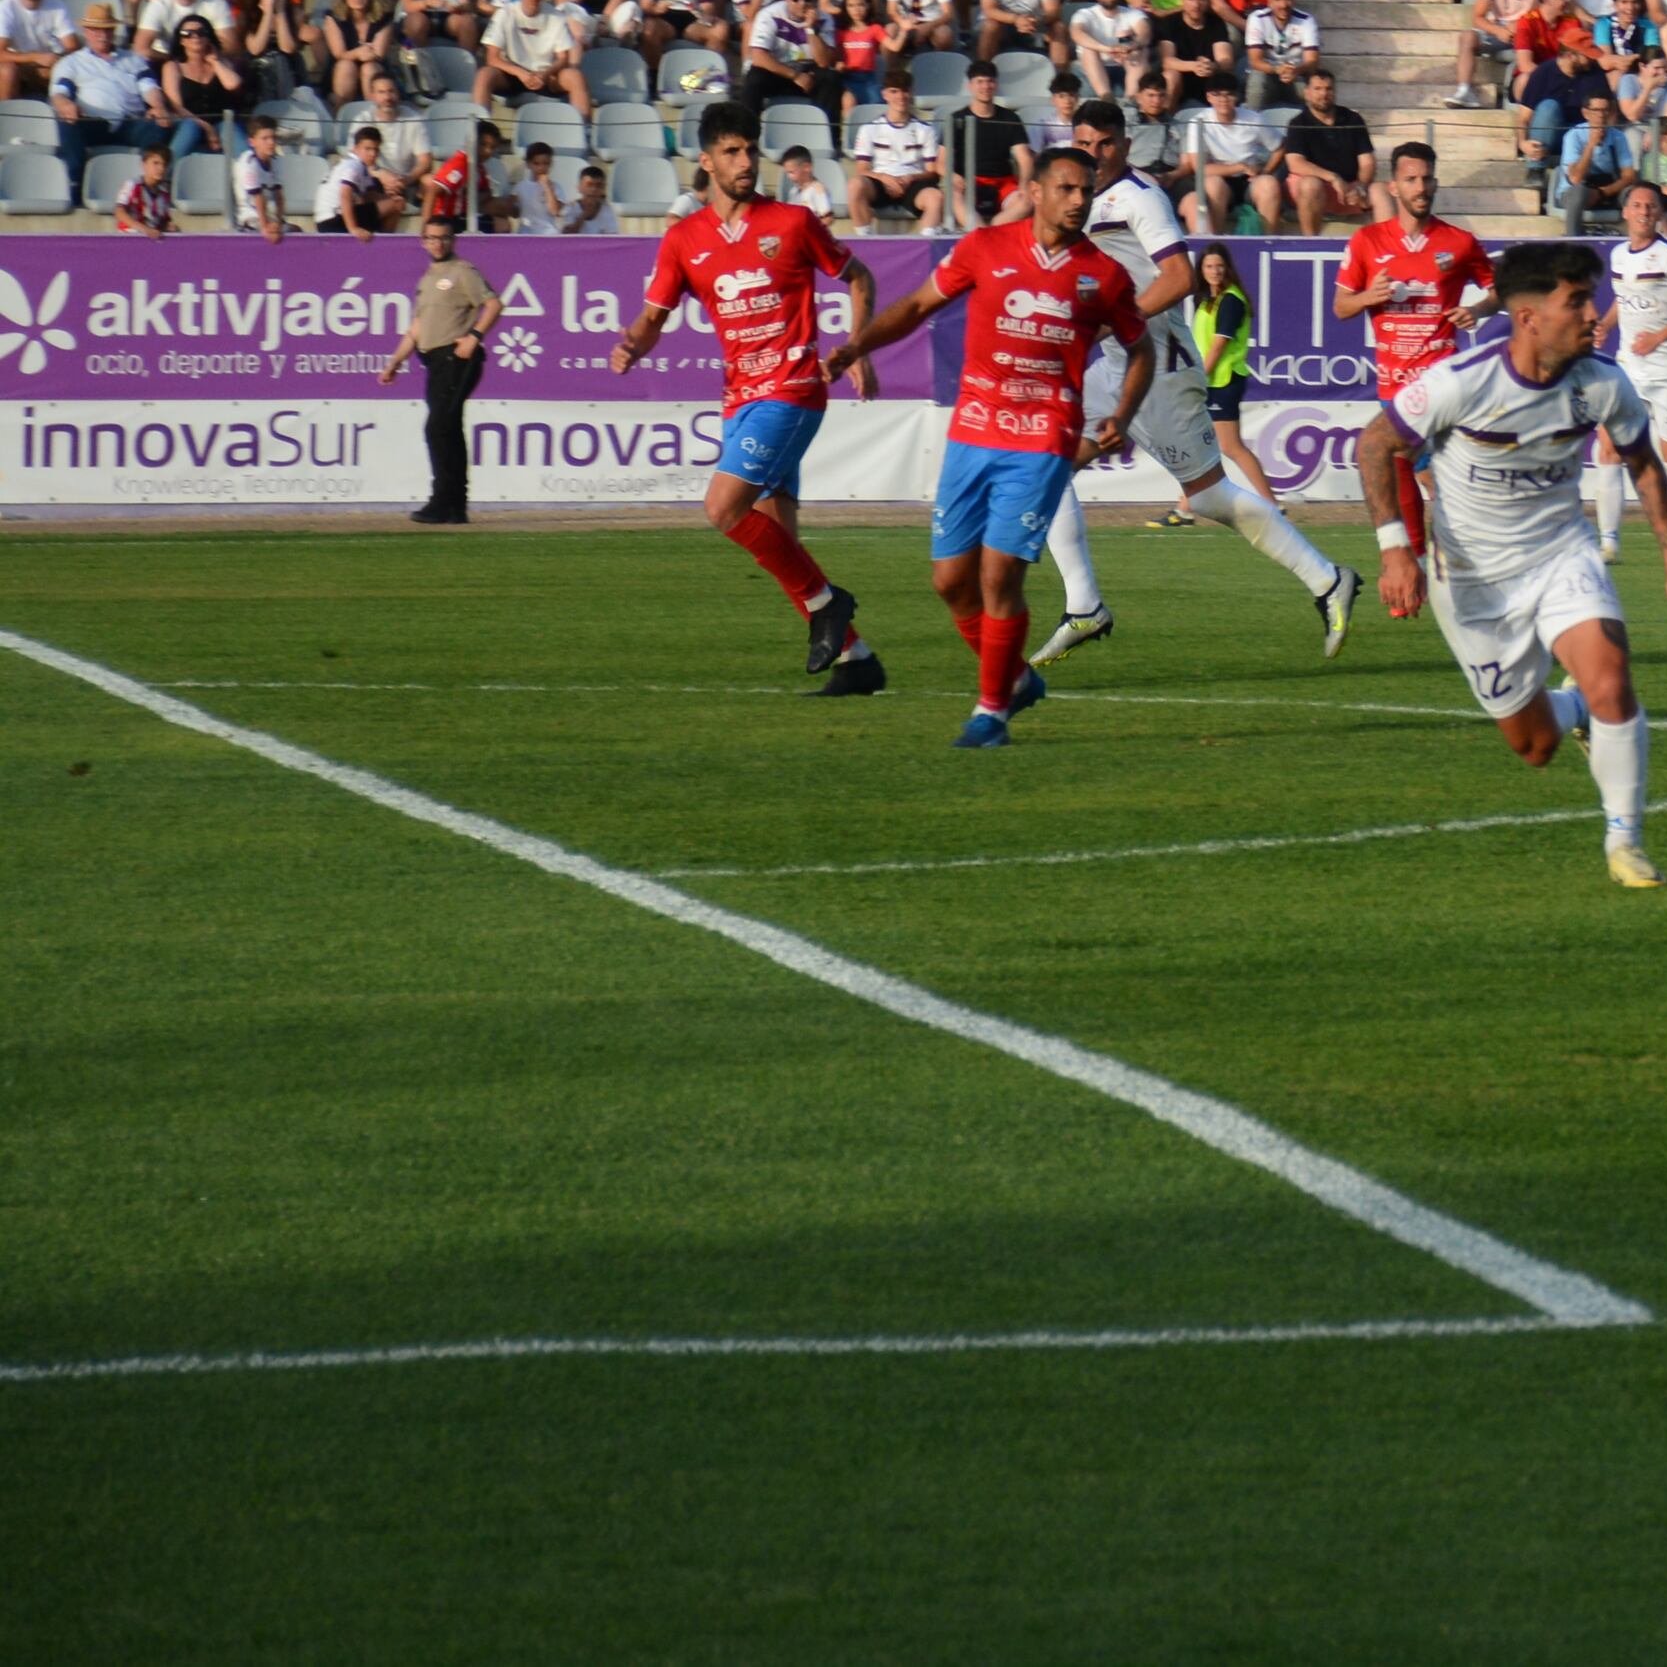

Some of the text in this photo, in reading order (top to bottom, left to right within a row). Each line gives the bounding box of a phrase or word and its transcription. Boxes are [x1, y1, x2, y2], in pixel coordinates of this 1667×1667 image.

[87, 277, 412, 351] aktivjaén
[995, 316, 1037, 335] CARLOS
[86, 350, 150, 378] ocio,
[158, 350, 261, 379] deporte
[269, 352, 287, 379] y
[21, 407, 377, 469] innovaSur
[472, 410, 722, 468] nnovaS
[112, 473, 364, 498] Knowledge Technology
